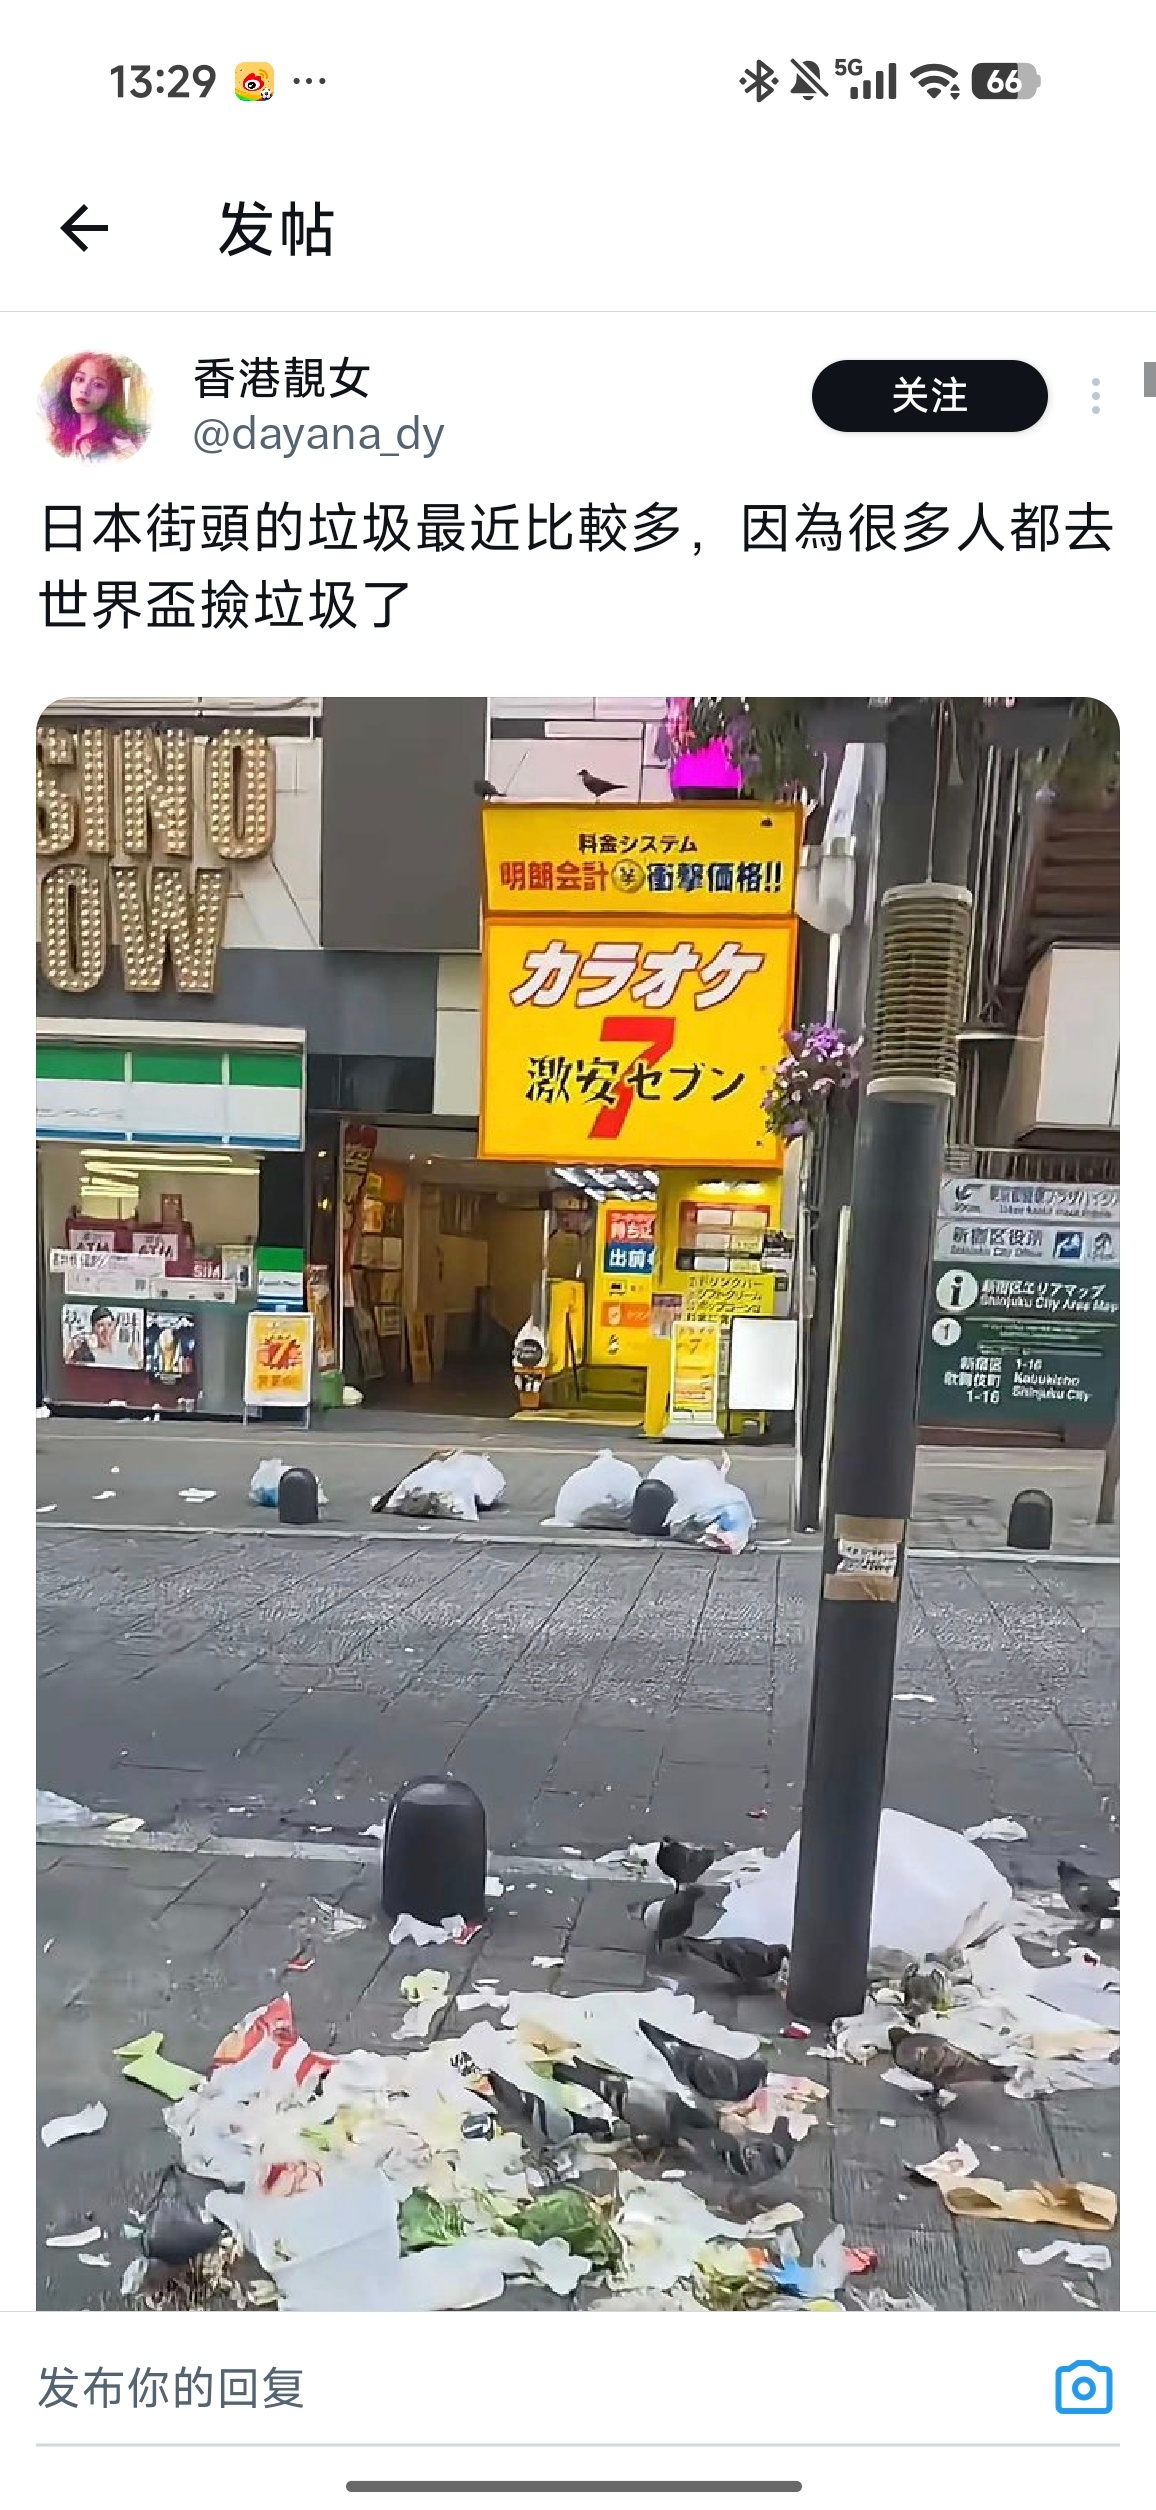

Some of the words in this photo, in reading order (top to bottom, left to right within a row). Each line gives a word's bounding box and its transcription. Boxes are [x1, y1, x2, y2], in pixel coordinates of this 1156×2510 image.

[578, 833, 697, 854] 料金システム
[499, 861, 609, 892] 明朗会計
[646, 861, 782, 893] 衝撃価格!!
[509, 939, 765, 1011] カラオケ
[587, 1016, 676, 1140] 7
[979, 1294, 1033, 1308] Shinjuku
[1035, 1297, 1061, 1312] City
[960, 1355, 1003, 1373] 新宿区
[966, 1390, 1000, 1404] 1-16
[1066, 1388, 1092, 1403] City
